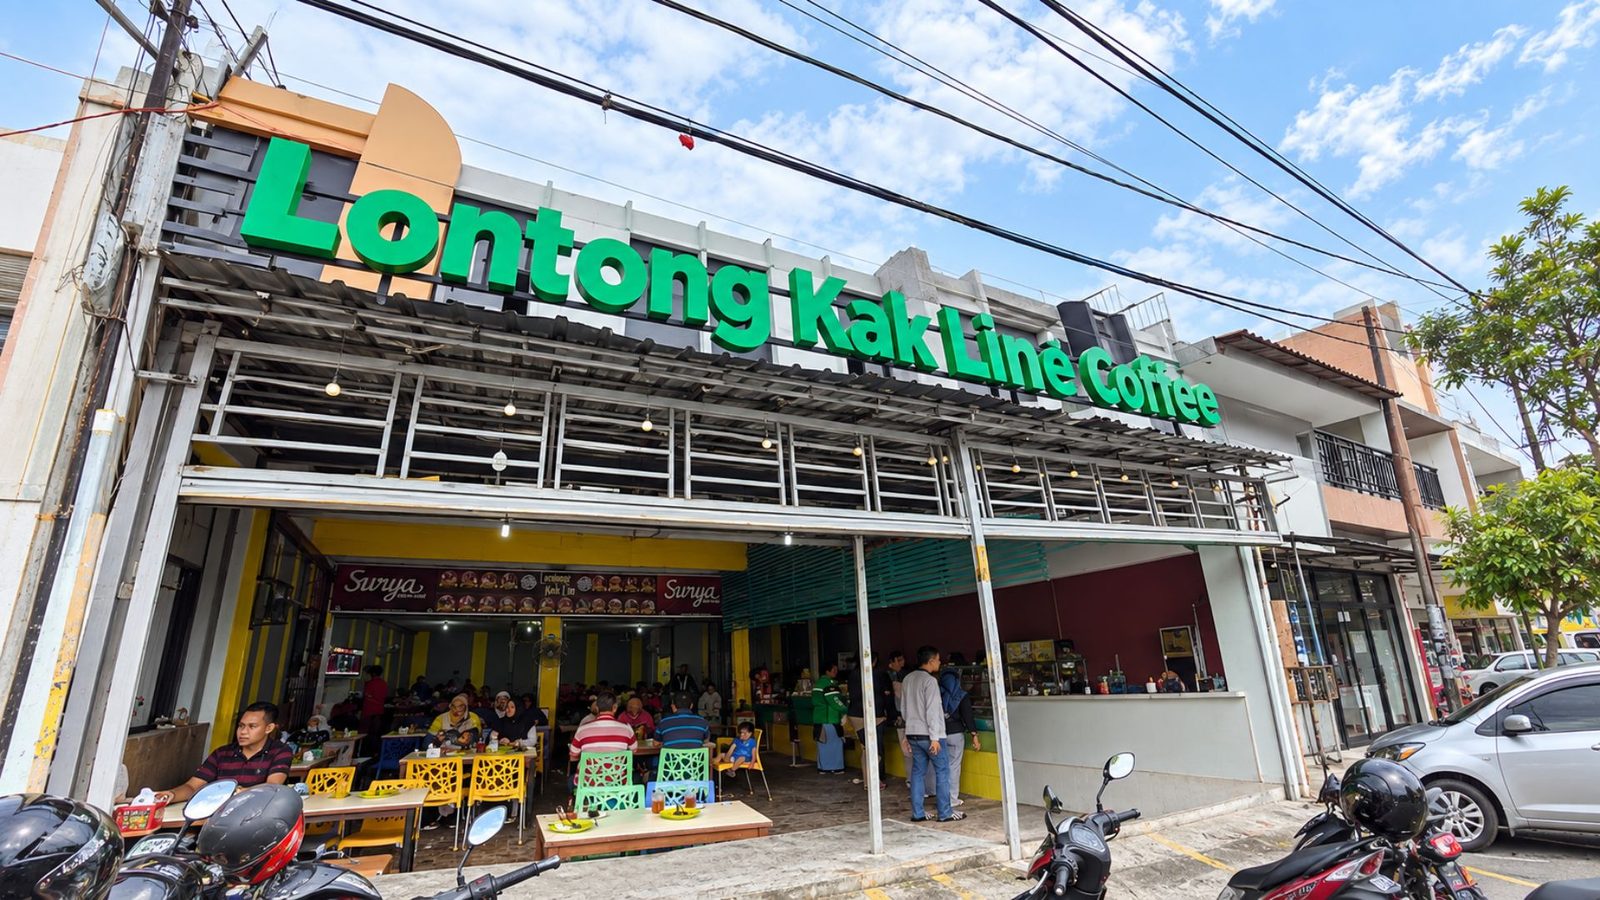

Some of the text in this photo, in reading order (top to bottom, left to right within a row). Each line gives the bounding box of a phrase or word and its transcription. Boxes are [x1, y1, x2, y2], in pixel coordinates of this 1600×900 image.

[240, 137, 770, 353] Lontong
[788, 267, 939, 373] Kak
[1078, 346, 1222, 428] Coffee
[344, 569, 424, 602] Surya
[664, 578, 721, 608] Surya
